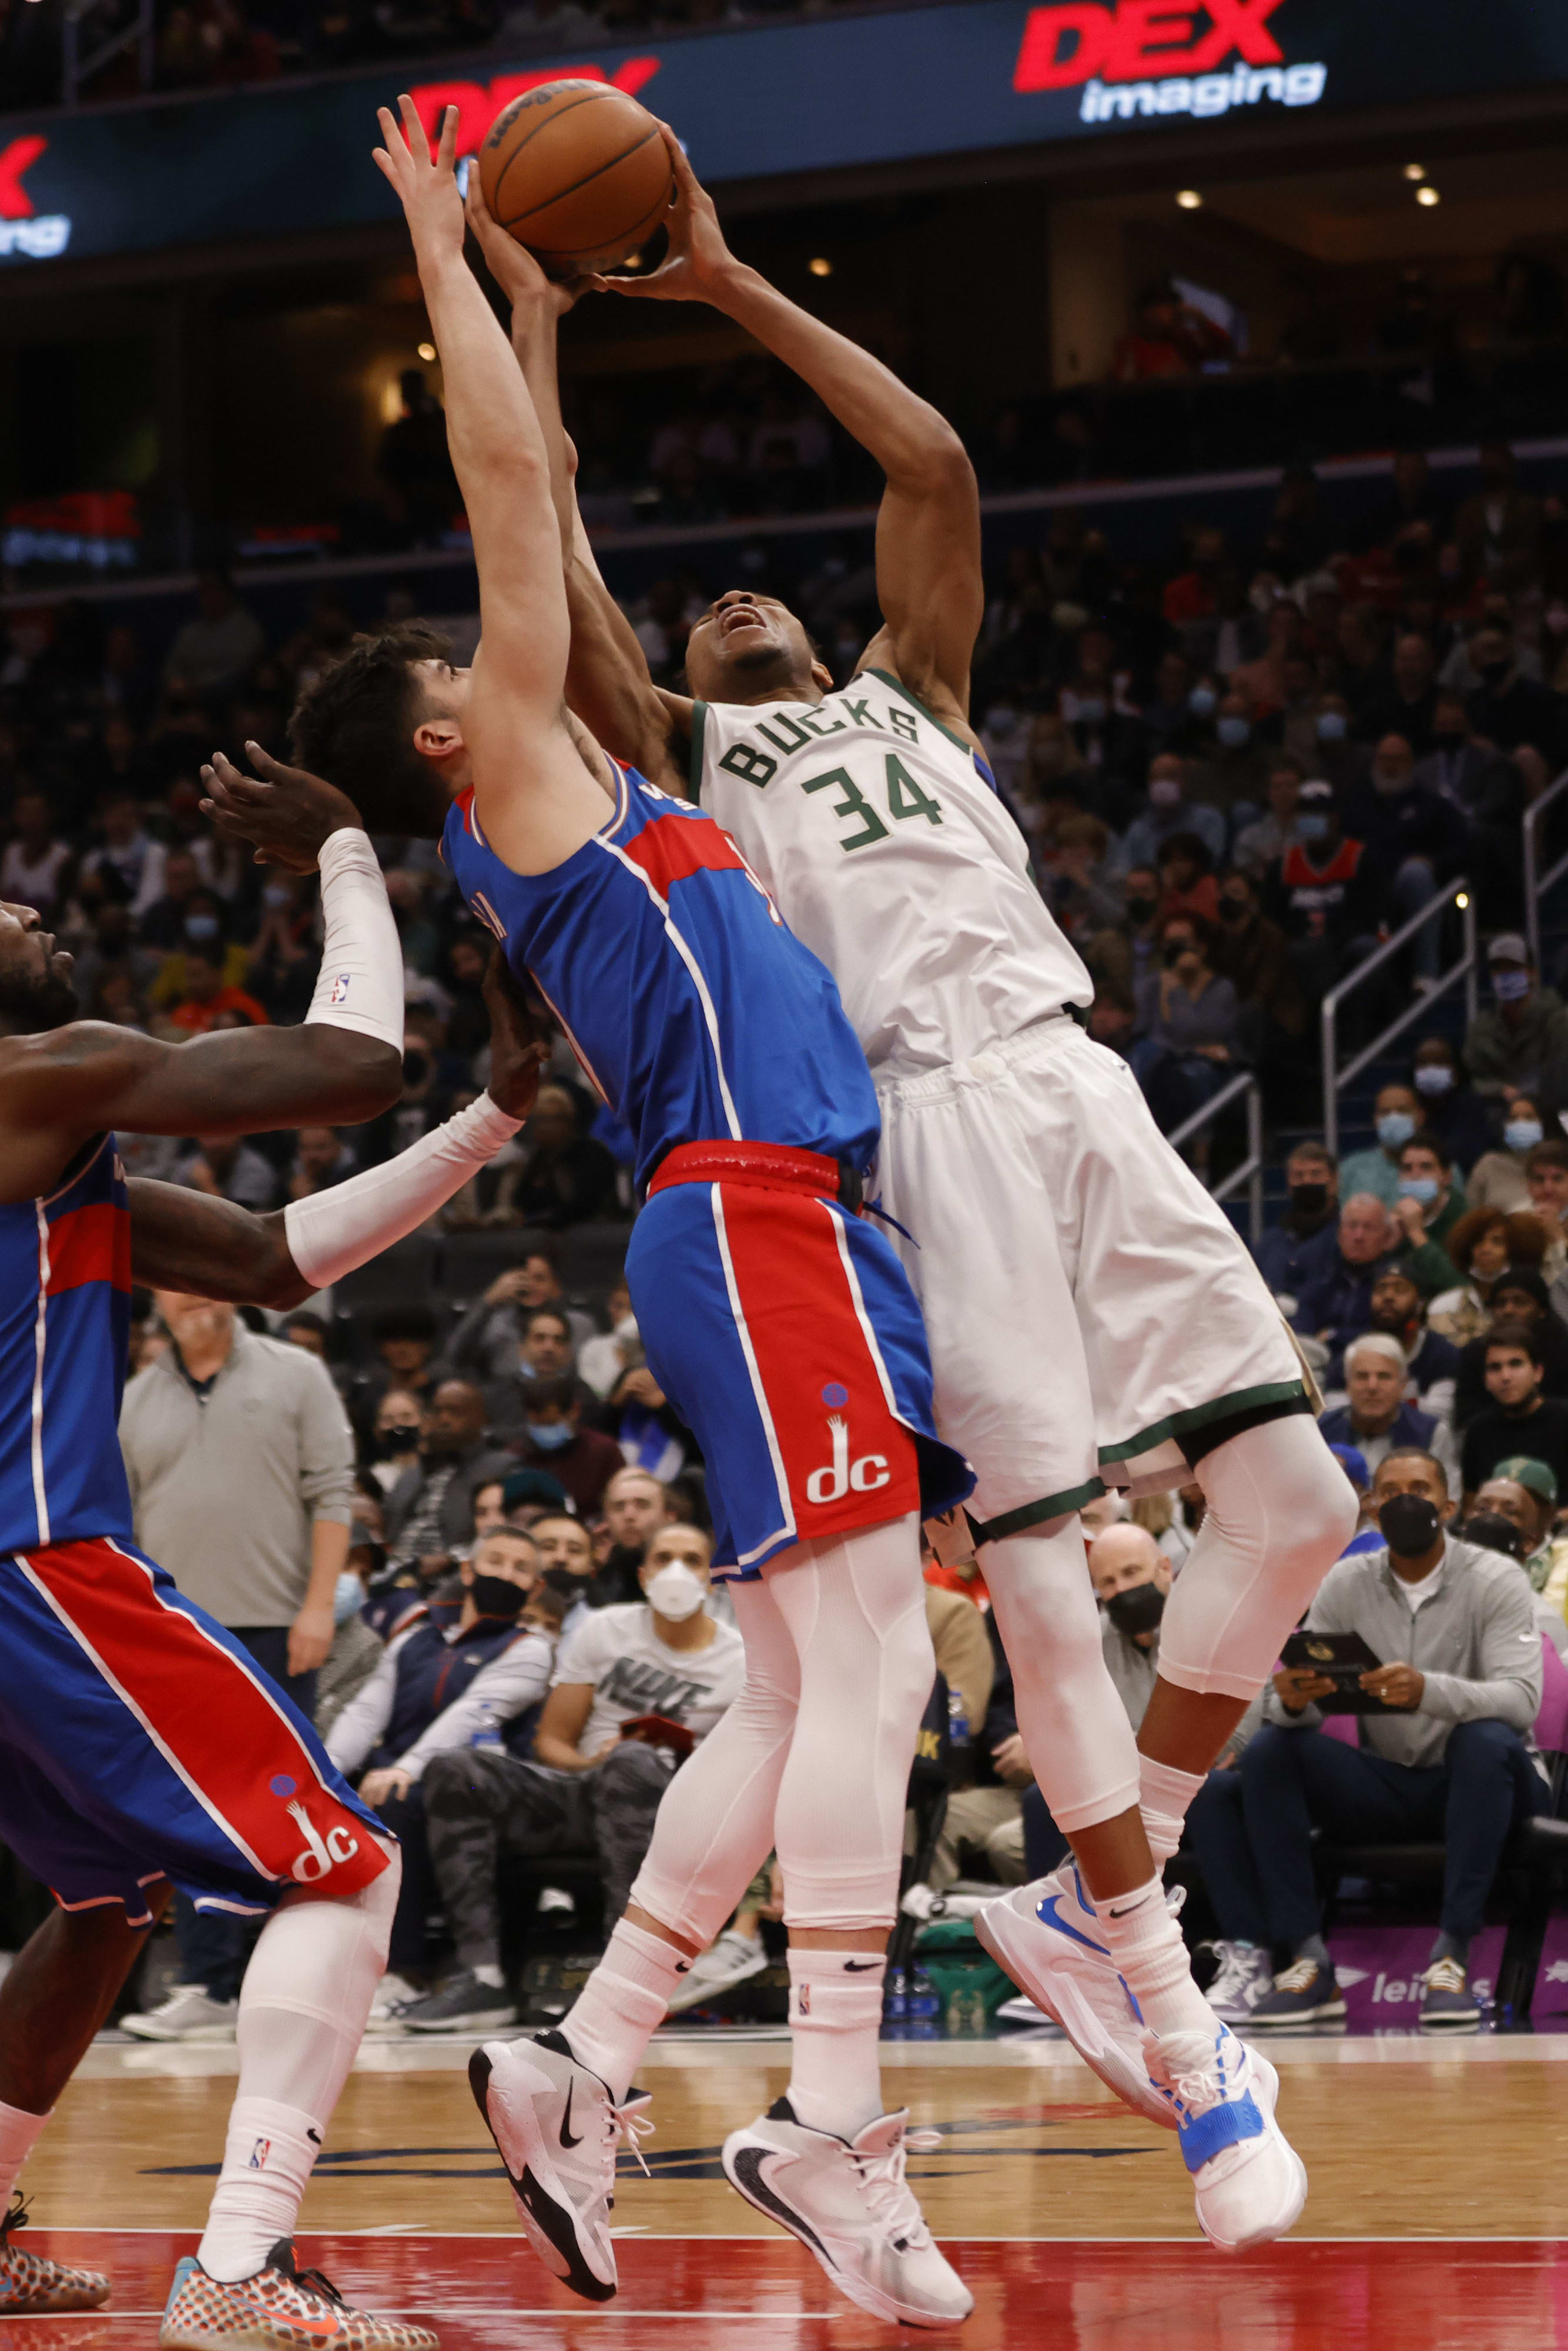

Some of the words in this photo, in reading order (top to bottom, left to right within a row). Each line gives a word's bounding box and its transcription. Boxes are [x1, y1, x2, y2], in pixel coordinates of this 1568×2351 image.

[1012, 0, 1286, 93] DEX
[1080, 61, 1327, 123] imaging
[718, 698, 920, 789] BUCKS
[800, 753, 946, 854] 34
[806, 1414, 890, 1504] dc
[292, 1800, 359, 1883] dc
[1371, 1971, 1492, 2003] leis
